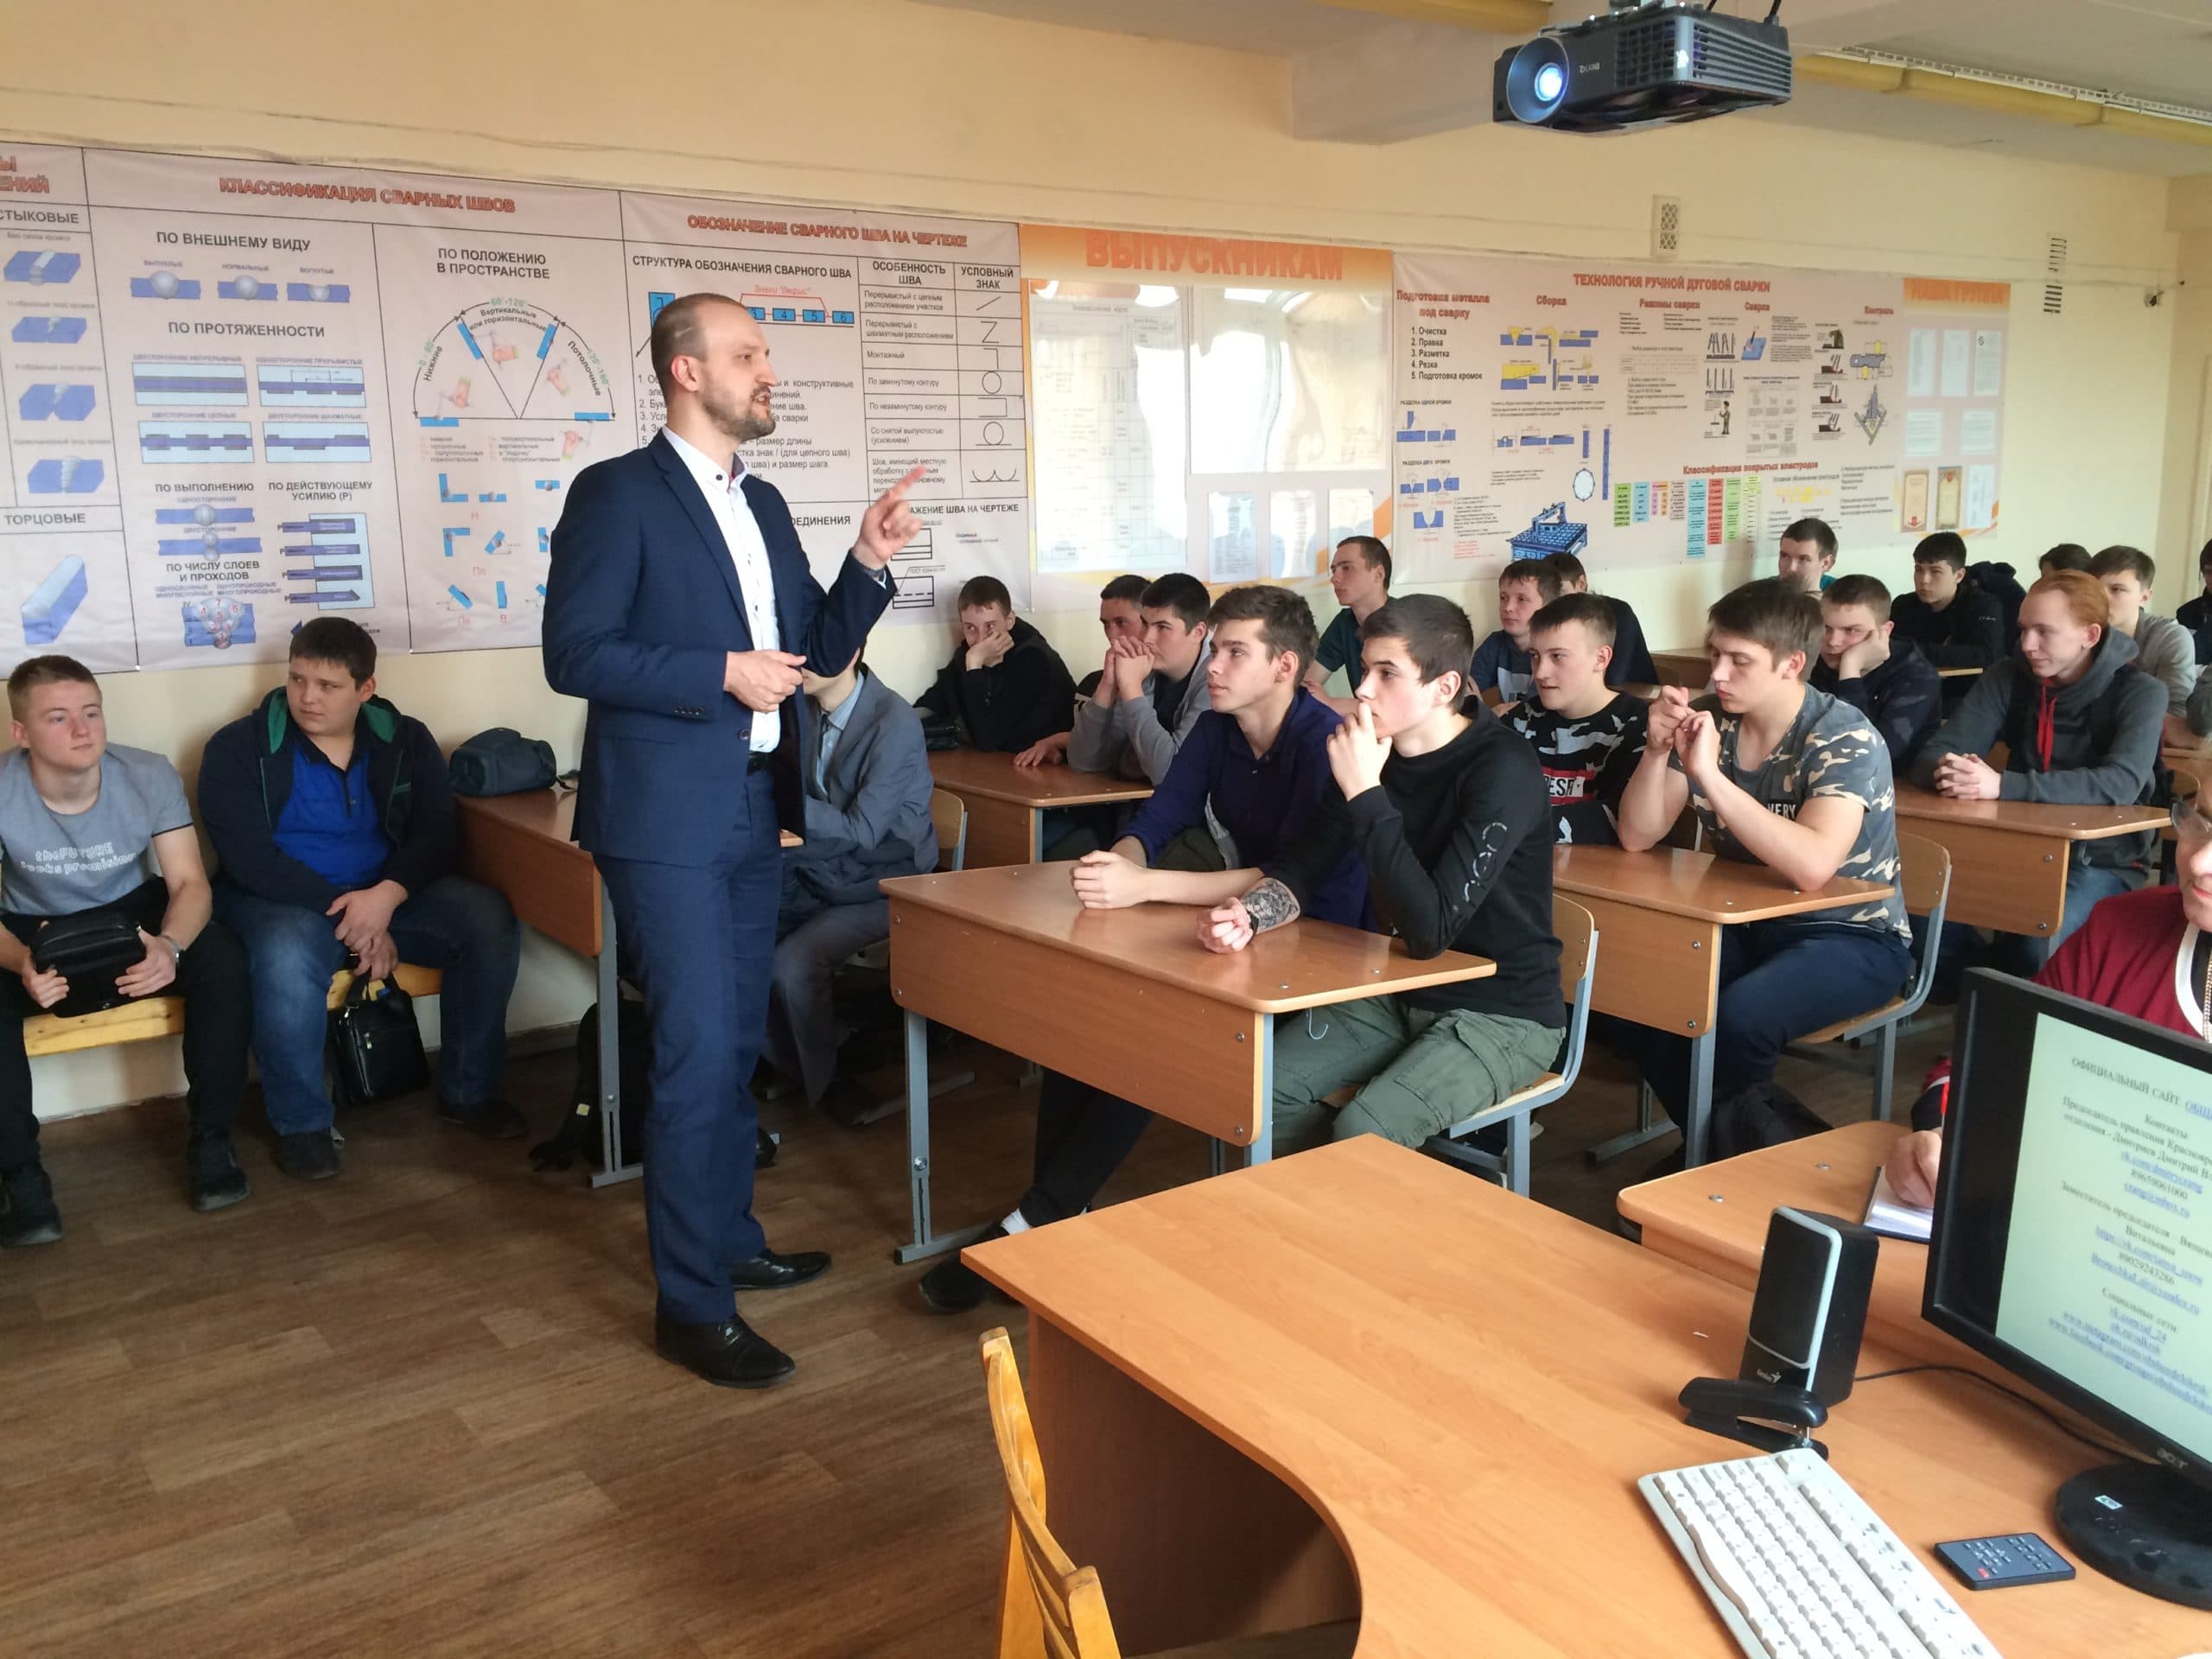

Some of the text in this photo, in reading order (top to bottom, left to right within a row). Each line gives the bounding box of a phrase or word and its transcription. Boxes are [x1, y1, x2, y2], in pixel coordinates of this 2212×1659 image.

[219, 177, 516, 213] КЛАССИФИКАЦИЯ СВАРНЫХ ШВОВ
[687, 215, 968, 247] ОБОЗНАЧЕНИЕ СВАРНОГО ШВА НА ЧЕРТЕЖЕ
[157, 232, 310, 252] ПО ВНЕШНЕМУ ВИДУ
[438, 248, 546, 265] ПО ПОЛОЖЕНИЮ
[1085, 233, 1344, 281] ВЫПУСКНИКАМ
[437, 263, 550, 279] В ПРОСТРАНСТВЕ
[632, 255, 852, 278] СТРУКТУРА ОБОЗНАЧЕНИЯ СВАРНОГО ШВА
[873, 261, 946, 275] ОСОБЕННОСТЬ
[961, 266, 1014, 278] УСЛОВНЫЙ
[899, 275, 923, 286] ШВА
[976, 279, 1001, 290] ЗНАК
[1573, 273, 1770, 293] ТЕХНОЛОГИЯ РУЧНОЙ ДУГОВОЙ СВАРКИ
[864, 290, 912, 300] Перерывистый
[1396, 289, 1491, 304] Подготовка металла
[864, 302, 915, 310] расположением
[1535, 295, 1567, 308] Сборка
[1674, 301, 1700, 311] сварки
[480, 308, 537, 320] Вертикальные
[781, 310, 847, 322] 4 5 6
[1420, 308, 1470, 321] под сварку
[168, 321, 325, 338] ПО ПРОТЯЖЕННОСТИ
[469, 316, 548, 332] или горизонтальные
[865, 319, 912, 329] Перерывистый
[905, 332, 954, 340] расположением
[1419, 326, 1447, 335] Очистка
[1419, 338, 1444, 346] Правка
[867, 350, 906, 359] Монтажный
[1419, 349, 1450, 359] Разметка
[424, 346, 443, 381] Нижние
[568, 340, 601, 397] Потолочные
[1419, 360, 1438, 369] Резка
[879, 378, 916, 387] замкнутому
[916, 378, 940, 387] контуру
[1419, 372, 1458, 381] Подготовка
[1459, 372, 1483, 382] кромок
[792, 380, 855, 390] конструктивные
[869, 402, 879, 410] По
[925, 404, 948, 412] контуру
[756, 437, 812, 447] размер длины
[780, 448, 798, 459] (для
[799, 449, 830, 459] цепного
[832, 448, 850, 458] шва)
[751, 461, 771, 469] шва)
[779, 461, 807, 470] размер
[888, 457, 919, 466] имеющий
[920, 458, 947, 467] местную
[1682, 464, 1742, 476] Классификация
[156, 483, 254, 493] ПО ВЫПОЛНЕНИЮ
[269, 480, 372, 492] ПО ДЕЙСТВУЮЩЕМУ
[292, 492, 336, 501] УСИЛИЮ
[910, 504, 1020, 515] АЖЕНИЕ ШВА НА ЧЕРТЕЖЕ
[5, 512, 86, 526] ТОРЦОВЫЕ
[166, 560, 260, 572] ПО ЧИСЛУ СЛОЕВ
[180, 571, 249, 582] И ПРОХОДОВ
[2072, 1057, 2150, 1095] ОФИЦИАЛЬНЫЙ
[2152, 1086, 2181, 1106] САЙТ
[2063, 1096, 2212, 1166] Председатель правления Краснояр
[2145, 1114, 2189, 1140] Контакты
[2112, 1131, 2156, 1157] Дмитриев
[2157, 1150, 2200, 1176] Дмитрий
[2061, 1179, 2112, 1211] Заместитель
[2113, 1206, 2171, 1238] председателя
[2101, 1286, 2155, 1321] Социальные
